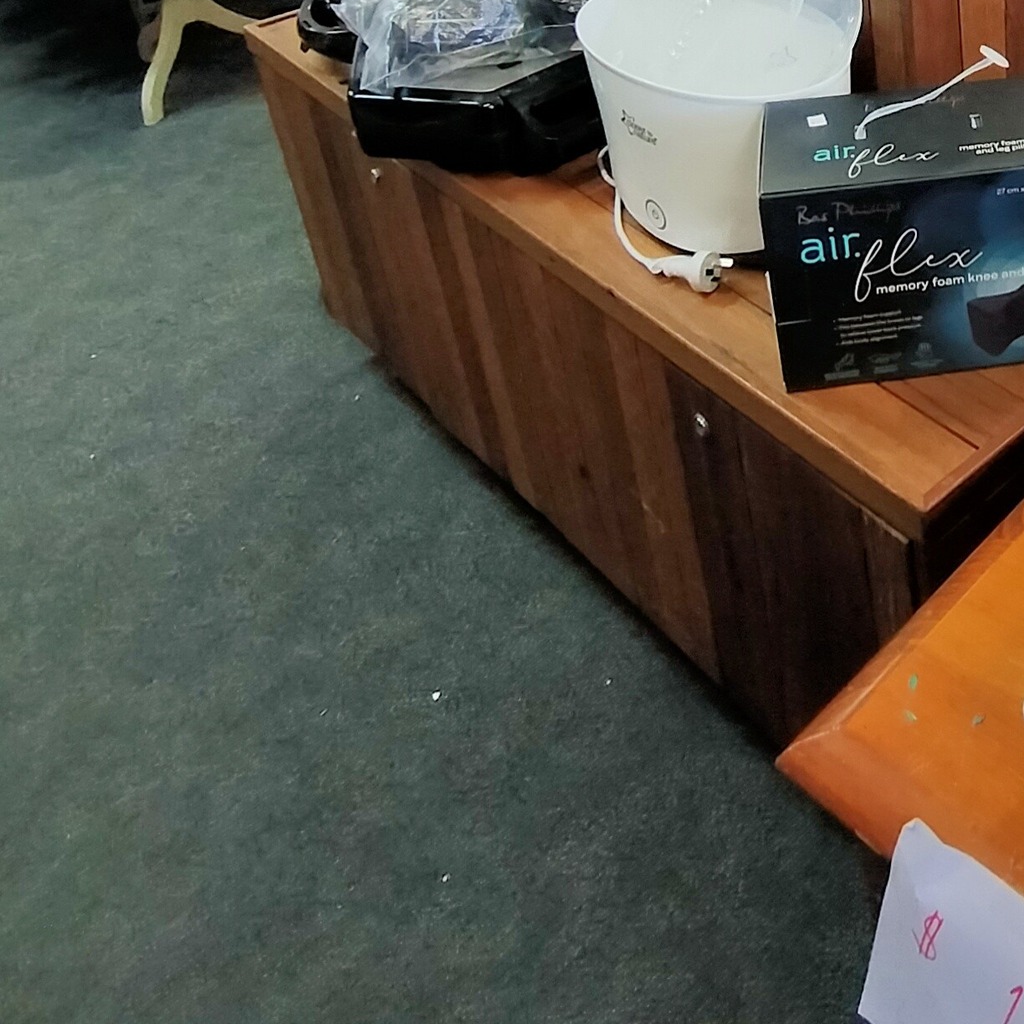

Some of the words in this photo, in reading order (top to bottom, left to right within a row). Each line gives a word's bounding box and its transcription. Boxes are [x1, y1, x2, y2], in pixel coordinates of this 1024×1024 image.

[959, 142, 999, 152] memory
[975, 147, 994, 155] and
[996, 145, 1010, 153] leg
[875, 279, 929, 295] memory
[932, 275, 965, 288] foam
[967, 272, 999, 283] knee
[1001, 266, 1024, 280] and
